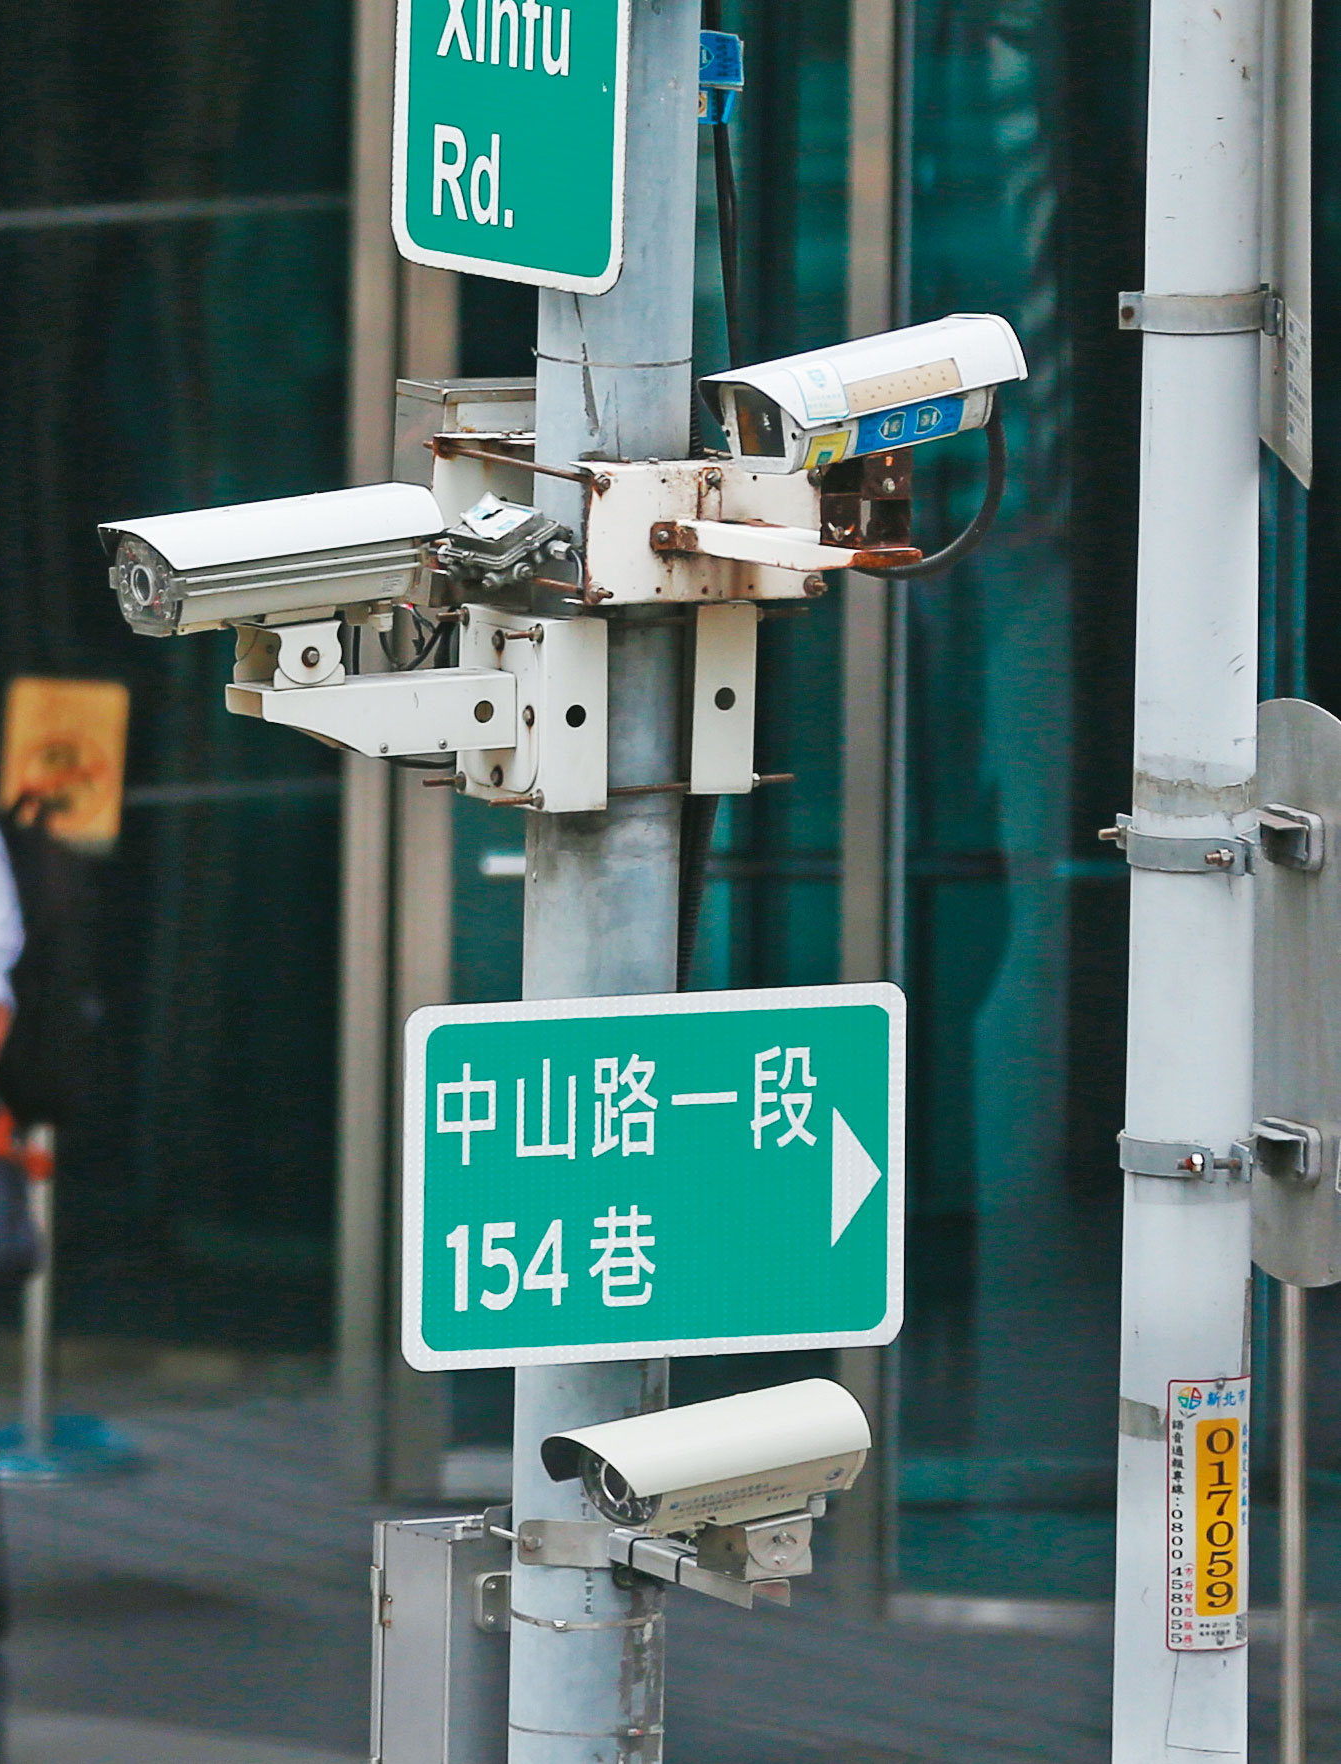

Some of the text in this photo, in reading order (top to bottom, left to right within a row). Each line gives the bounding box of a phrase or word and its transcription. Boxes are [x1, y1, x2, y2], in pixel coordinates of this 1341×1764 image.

[436, 0, 571, 77] Xinfu
[432, 123, 515, 229] Rd.
[435, 1045, 819, 1167] 中山路一段
[1205, 1427, 1236, 1609] 017059
